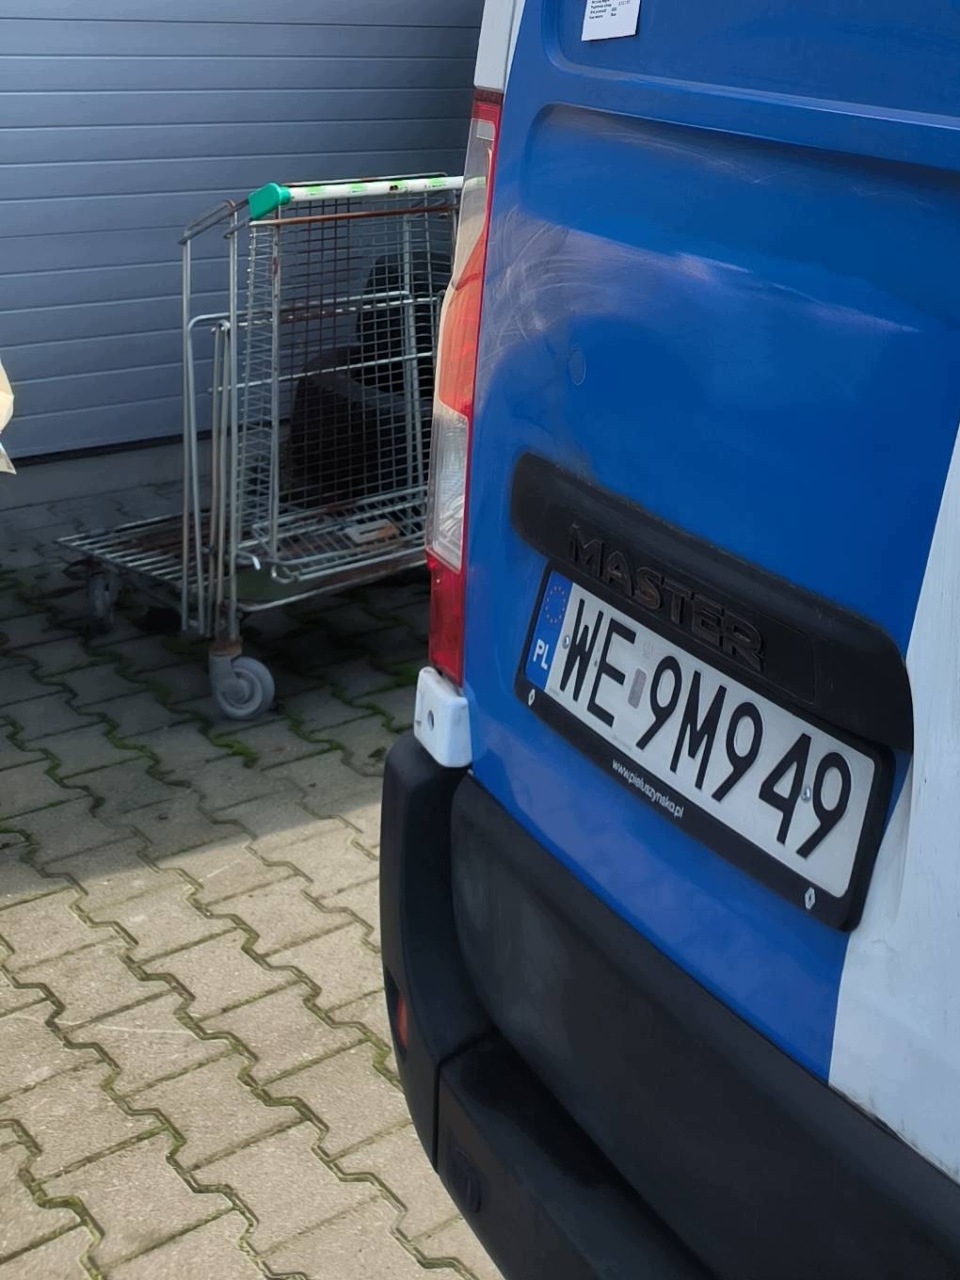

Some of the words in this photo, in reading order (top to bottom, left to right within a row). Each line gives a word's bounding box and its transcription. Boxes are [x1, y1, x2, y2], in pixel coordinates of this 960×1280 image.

[532, 638, 549, 670] PL
[569, 524, 766, 671] MASTER
[560, 598, 636, 728] WE
[635, 655, 852, 859] 9M949
